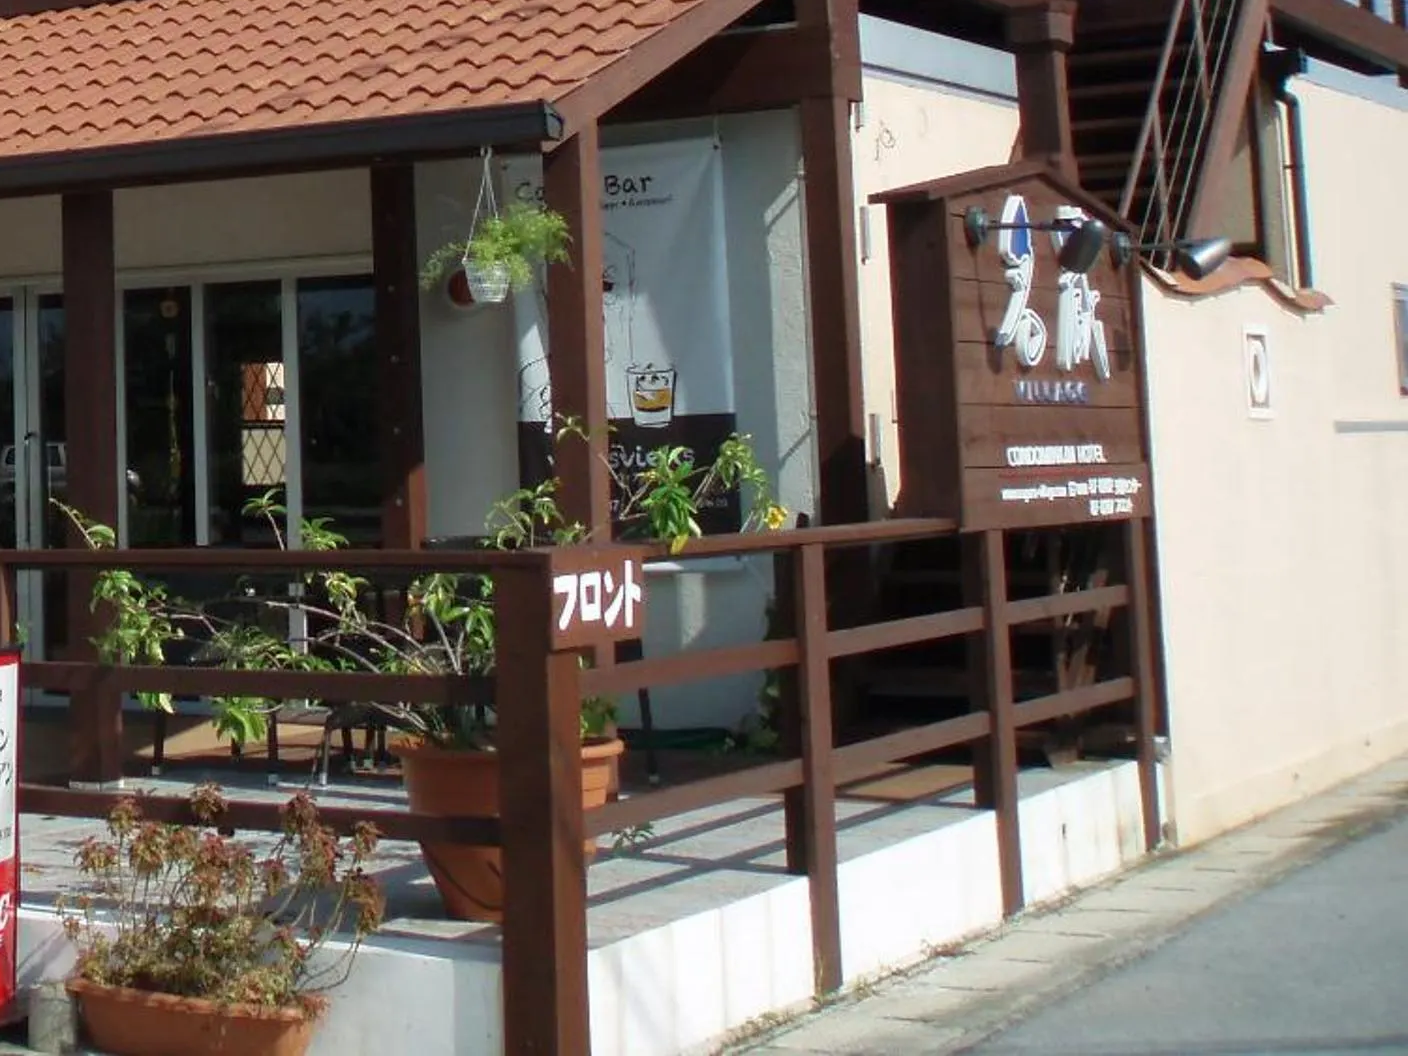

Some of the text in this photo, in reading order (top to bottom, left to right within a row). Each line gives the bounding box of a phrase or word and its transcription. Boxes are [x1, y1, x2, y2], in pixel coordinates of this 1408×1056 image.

[604, 174, 652, 195] Bar
[553, 560, 641, 630] フロント
